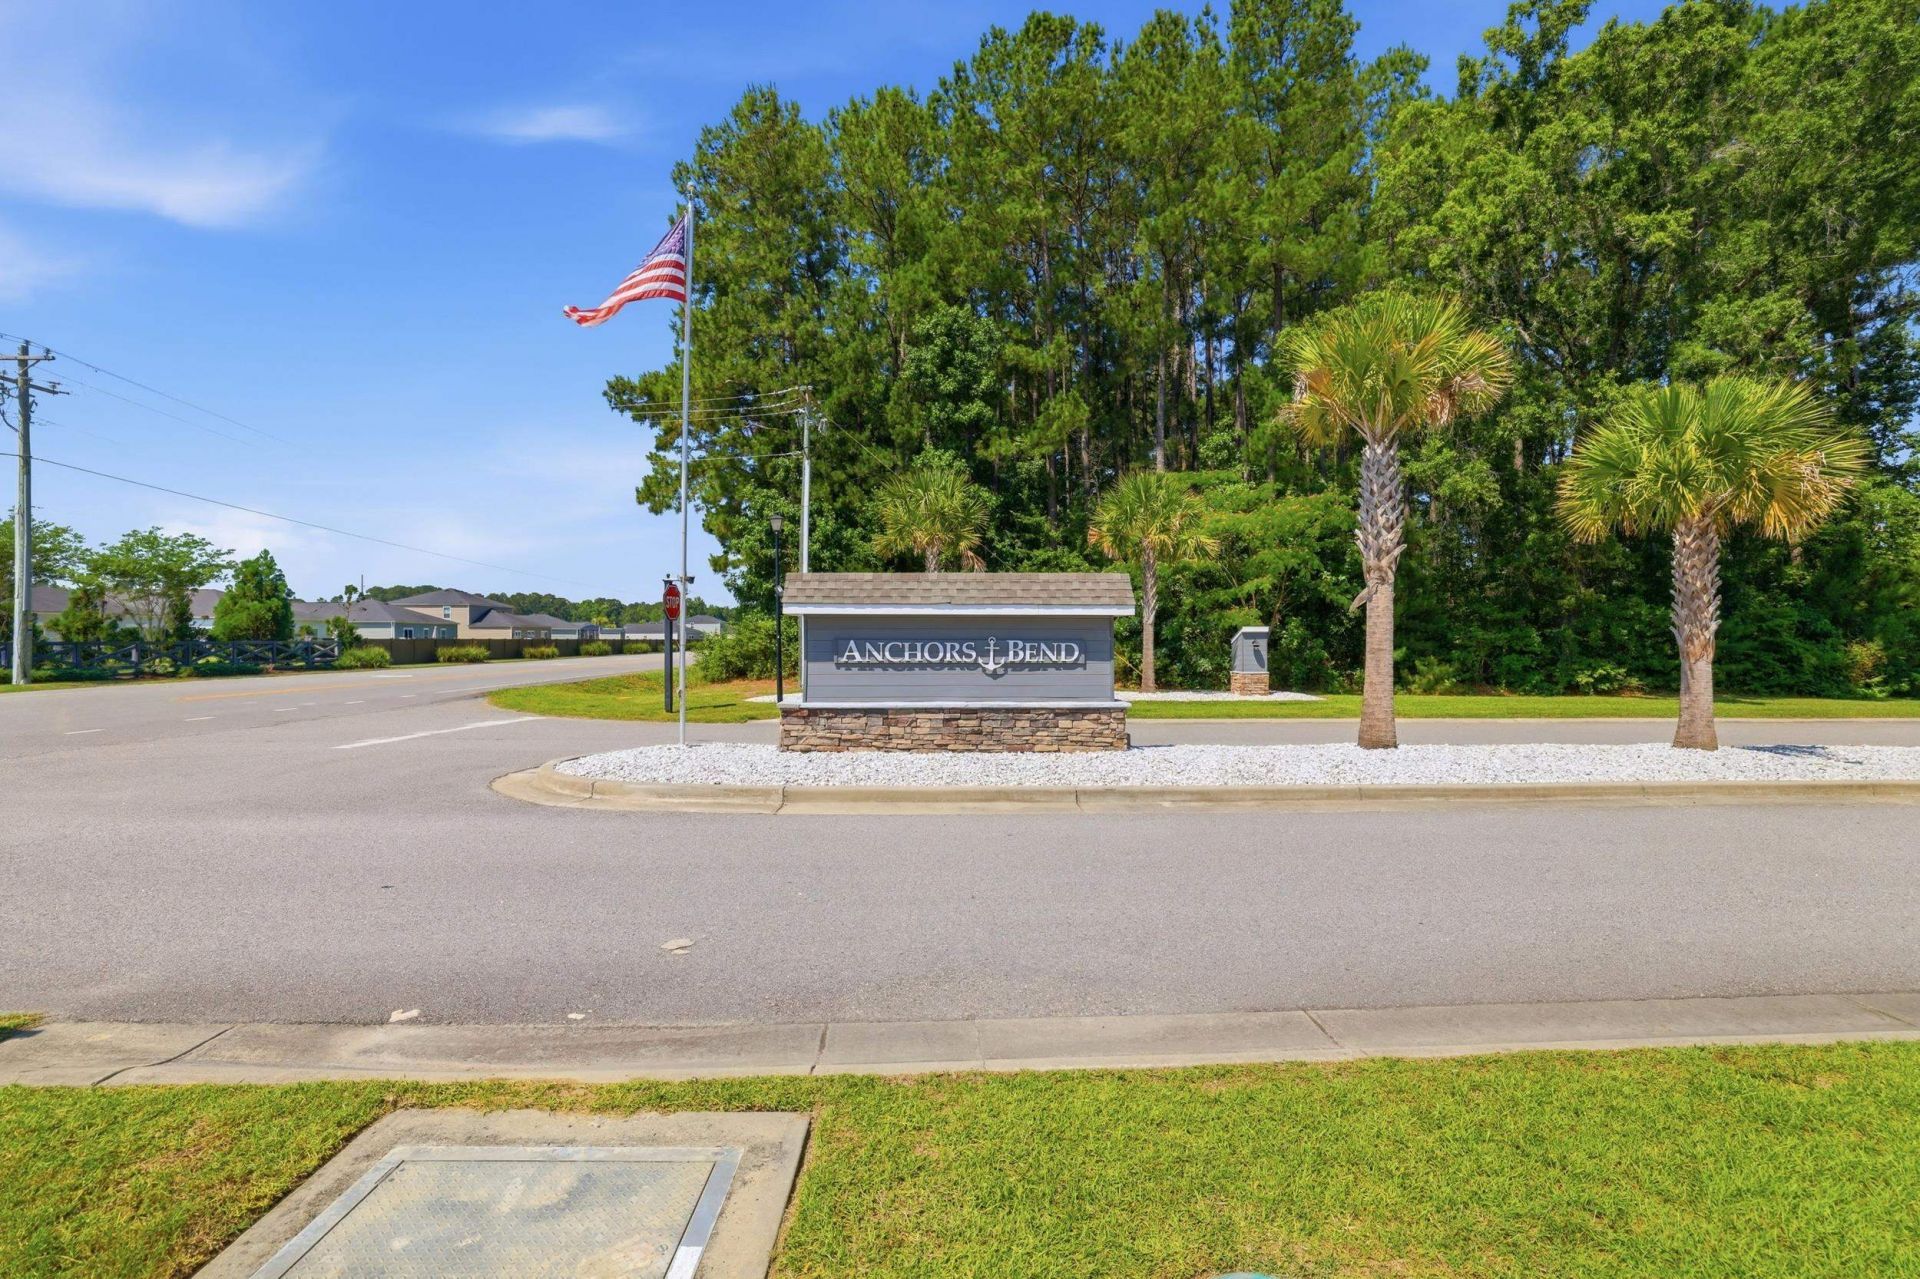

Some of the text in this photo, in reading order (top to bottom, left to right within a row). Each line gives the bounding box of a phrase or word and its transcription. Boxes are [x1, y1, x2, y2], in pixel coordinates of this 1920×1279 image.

[666, 596, 680, 609] STOP
[841, 640, 1080, 663] ANCHORS BEND
